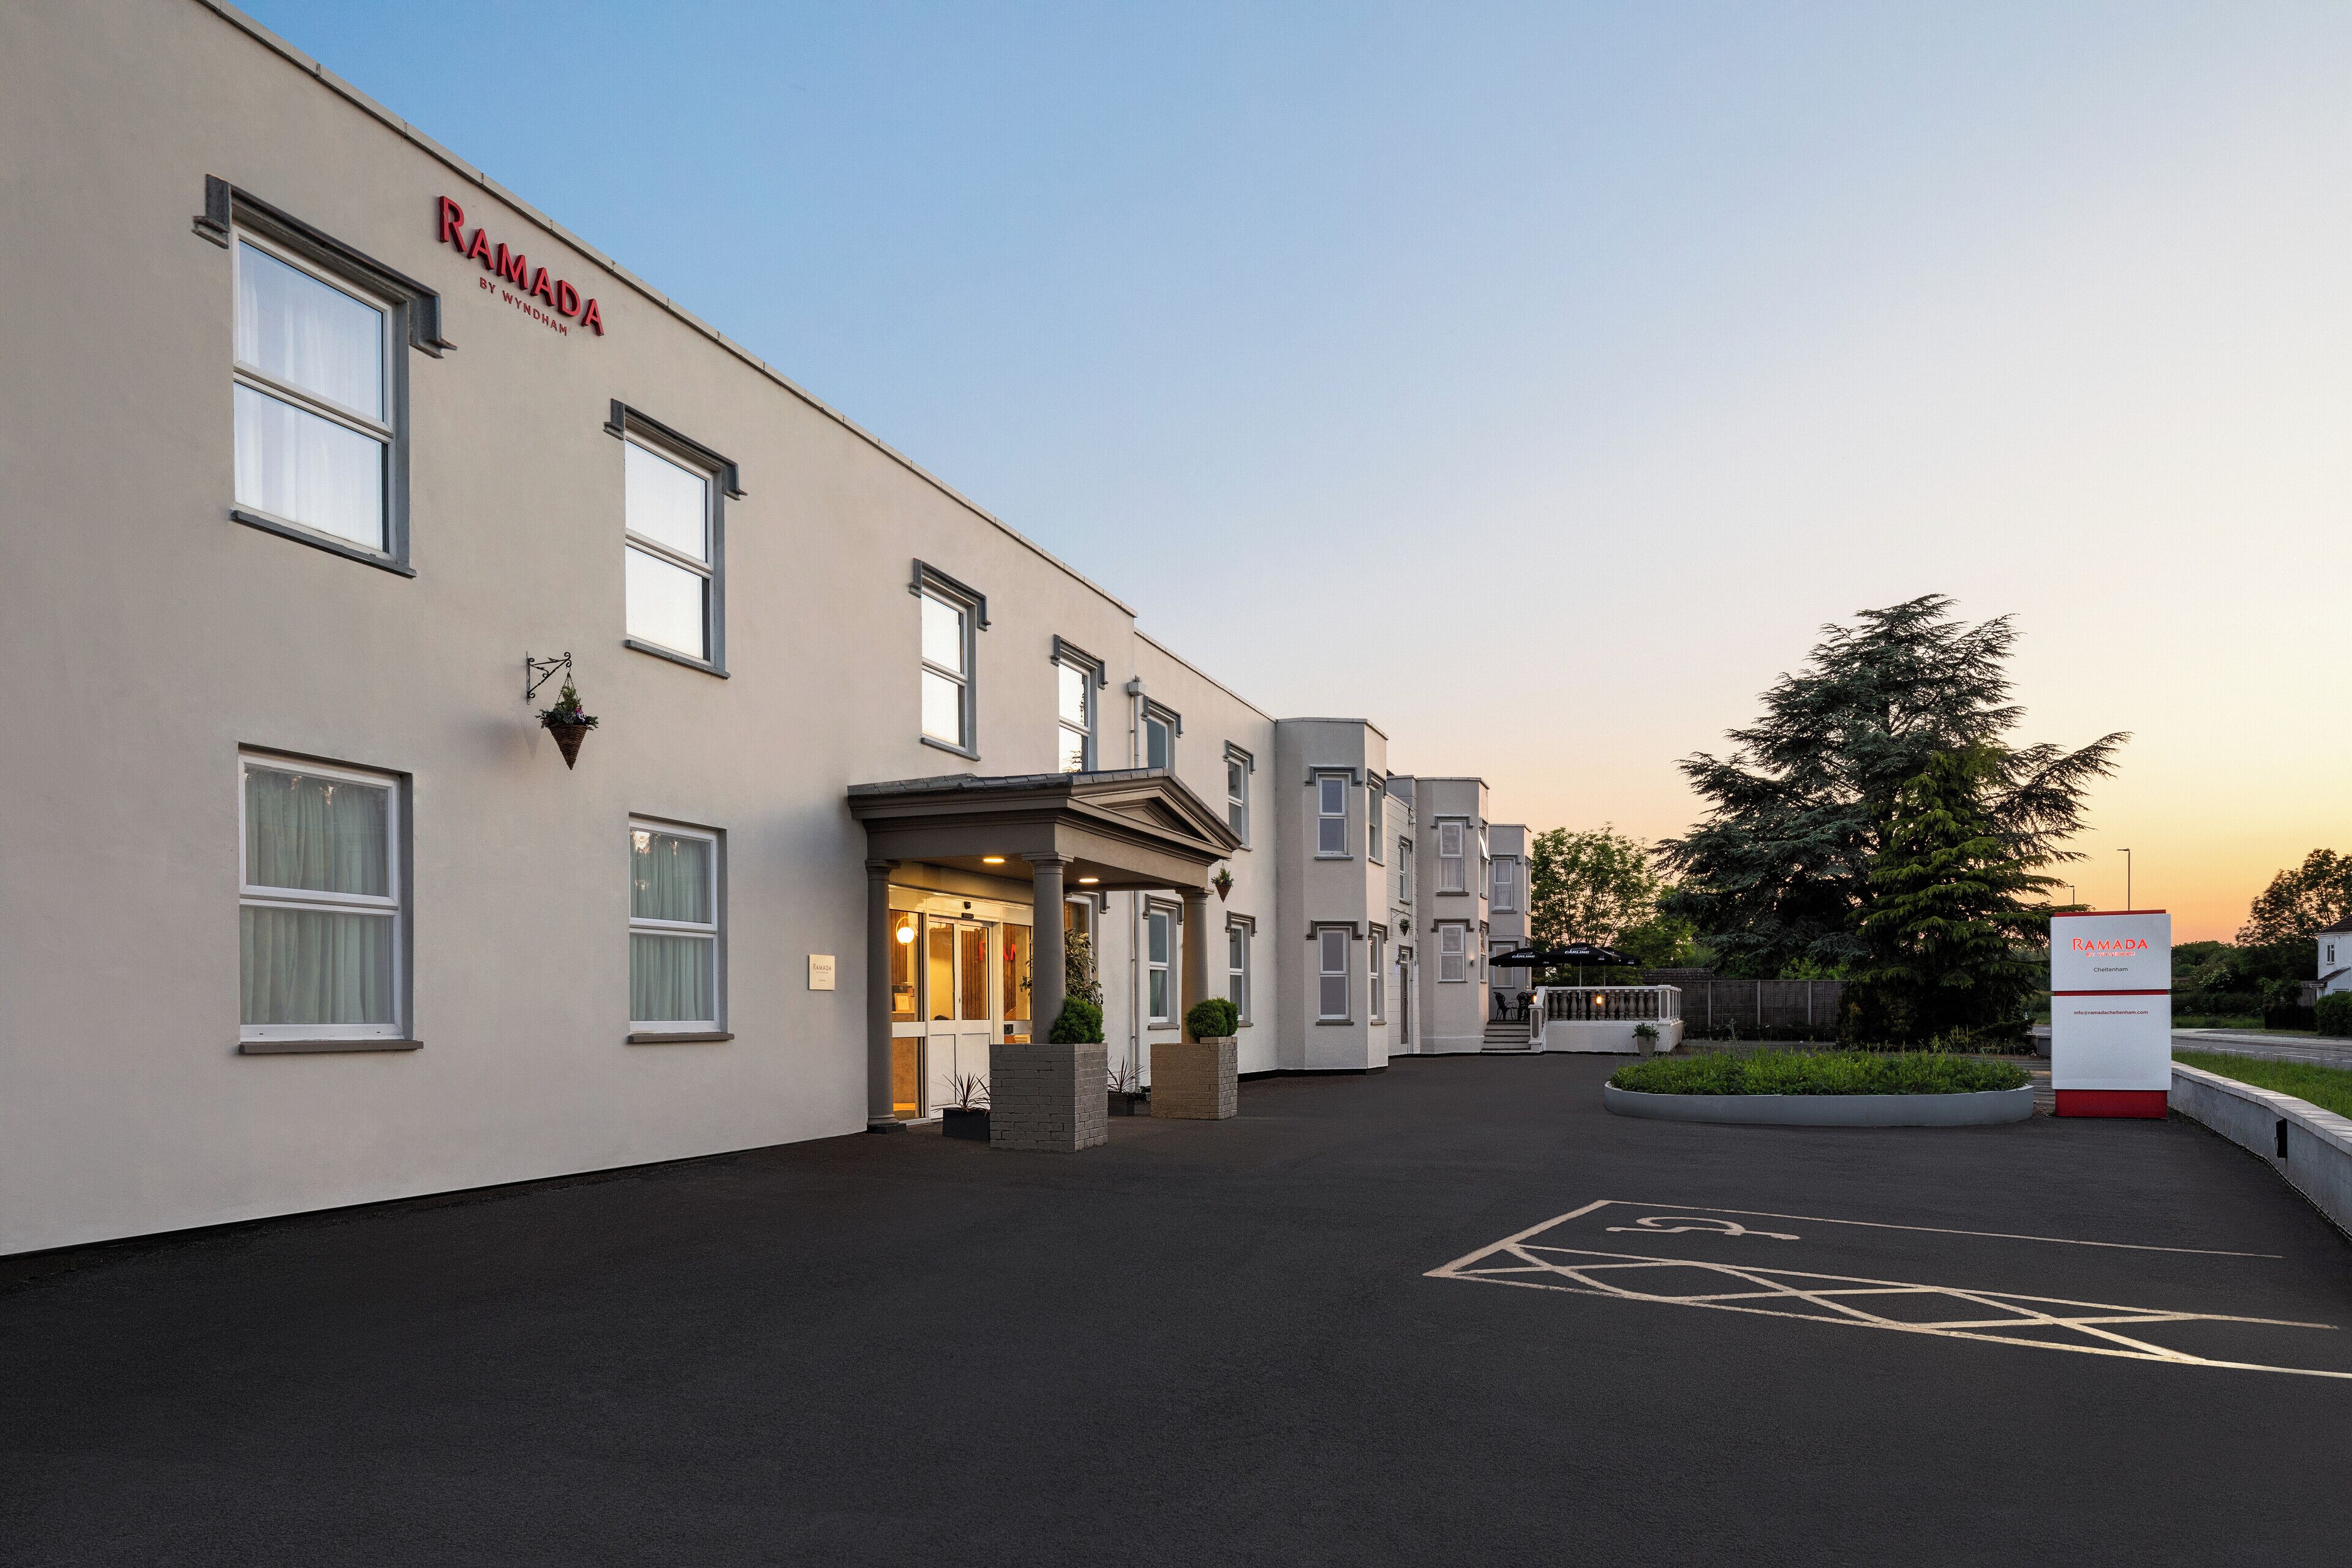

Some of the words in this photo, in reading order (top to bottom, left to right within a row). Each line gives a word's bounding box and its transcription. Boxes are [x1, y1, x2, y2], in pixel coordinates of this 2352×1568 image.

[438, 195, 605, 336] RAMADA
[480, 277, 496, 294] BY
[502, 290, 567, 336] WYNDHAM
[2073, 938, 2148, 951] RAMADA
